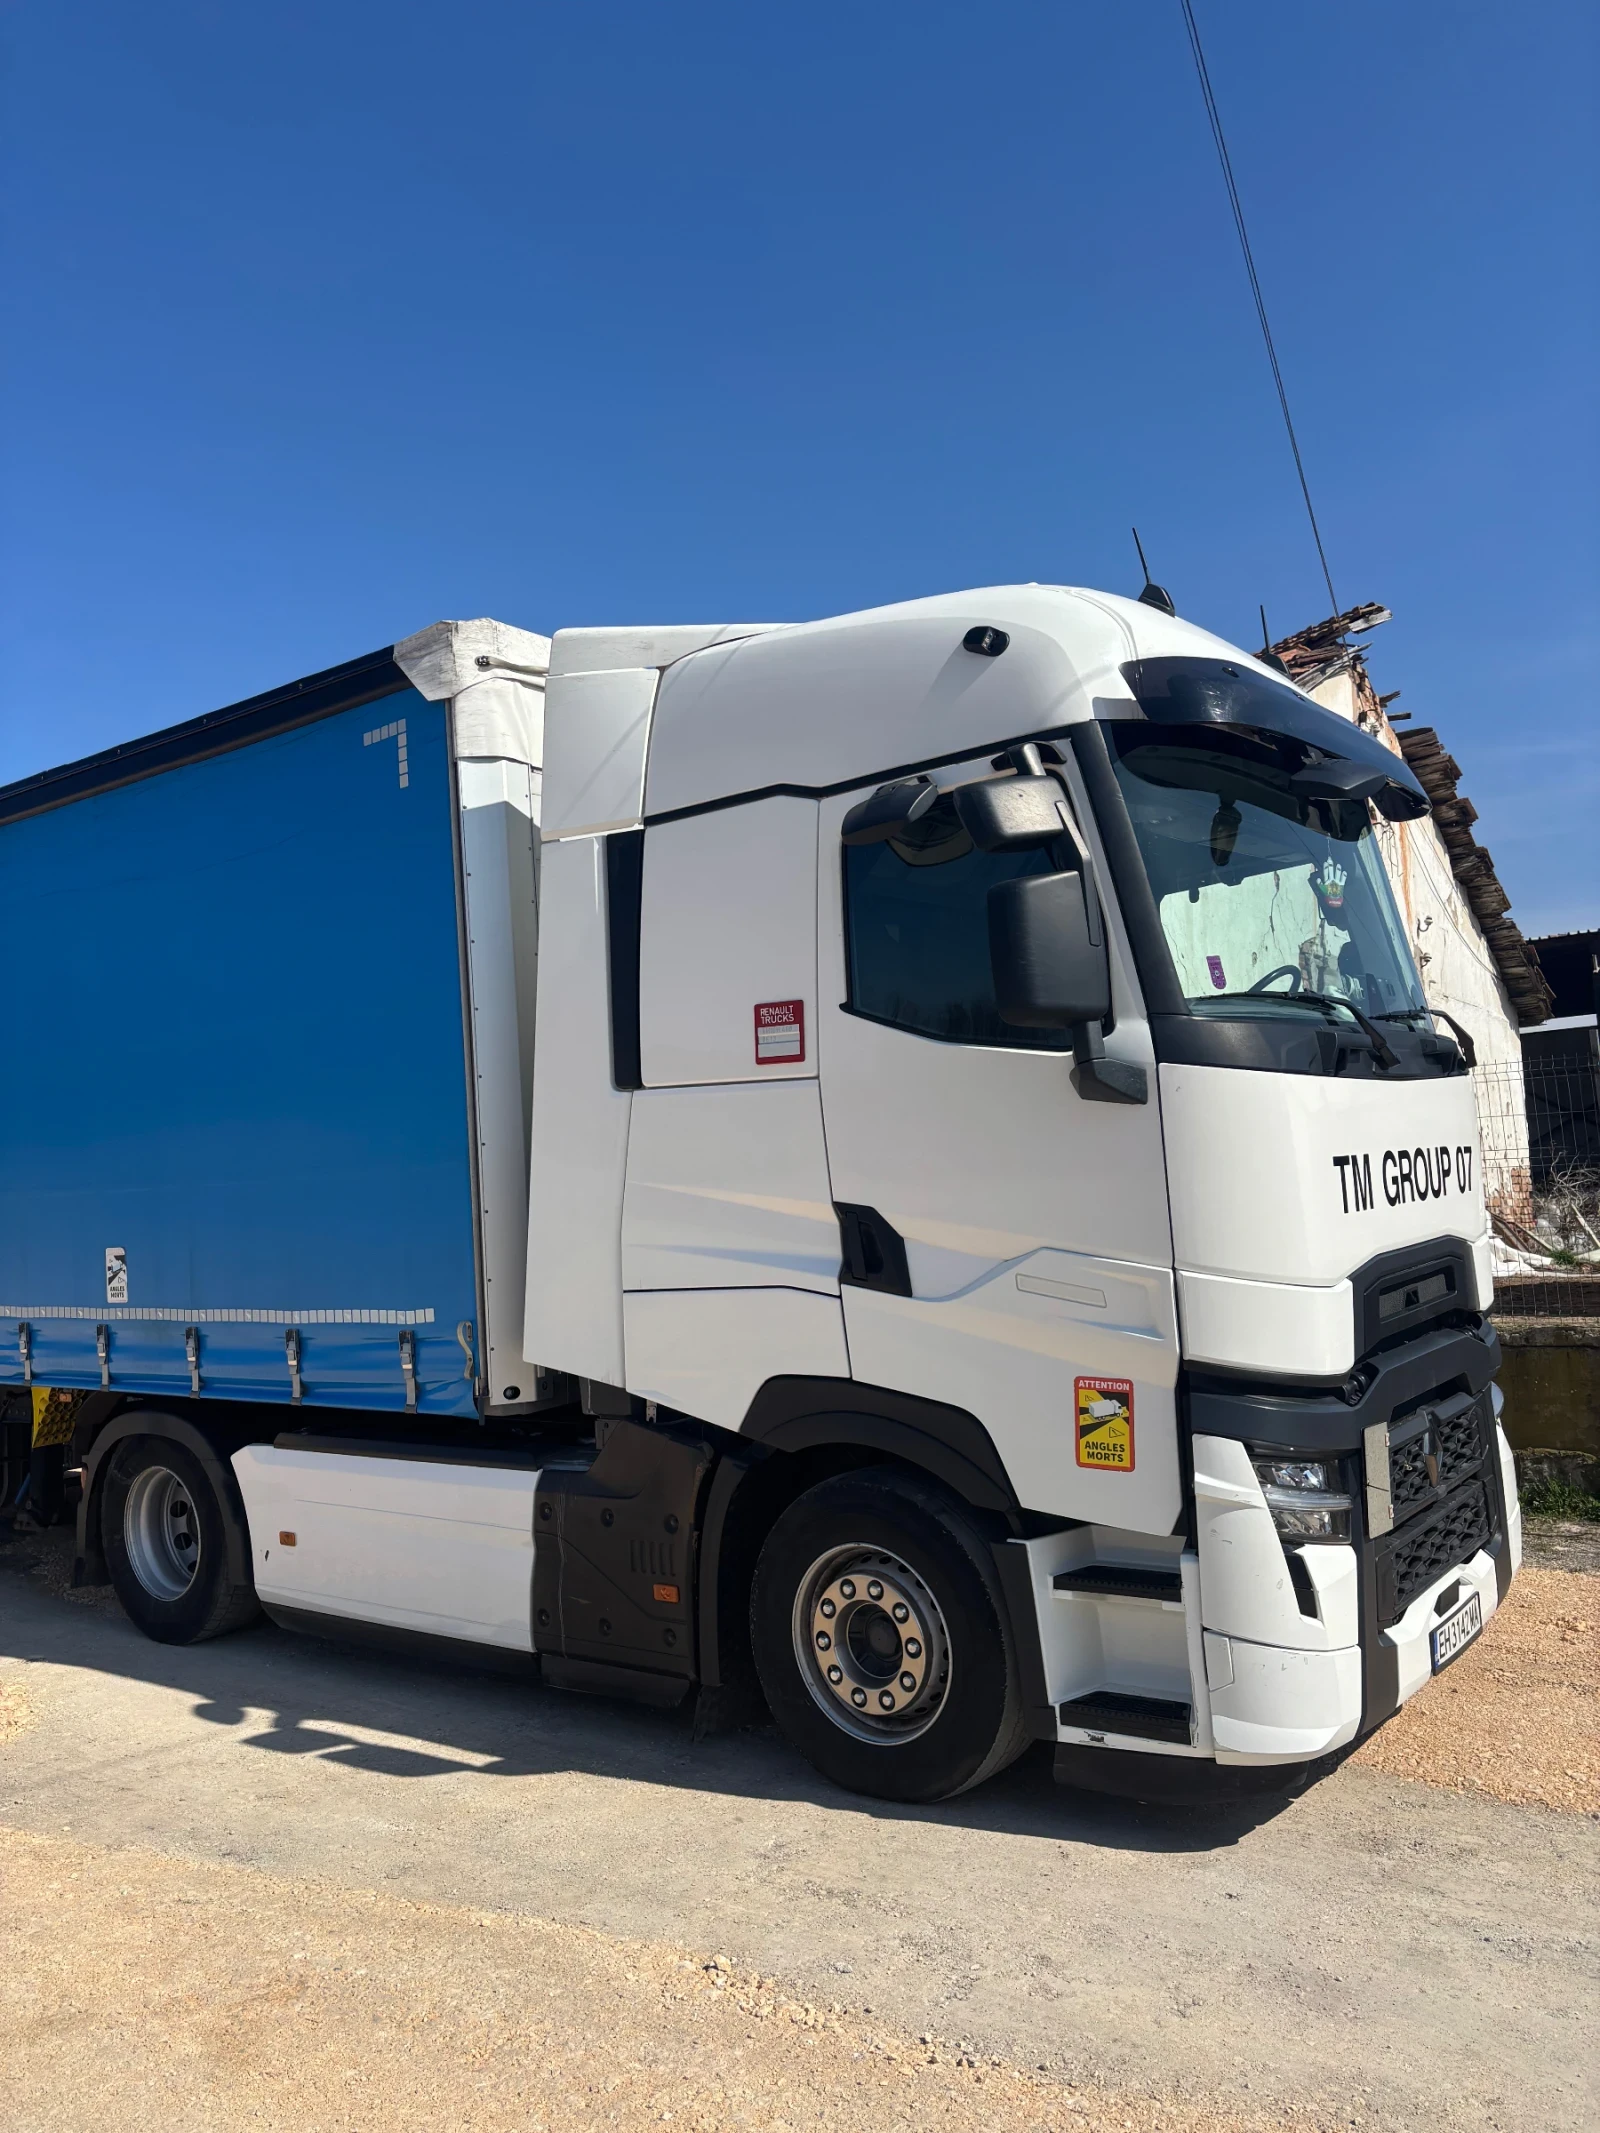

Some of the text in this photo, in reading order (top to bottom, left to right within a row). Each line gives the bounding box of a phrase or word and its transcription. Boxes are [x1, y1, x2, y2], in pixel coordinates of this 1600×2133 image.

[760, 1005, 794, 1017] RENAULT
[761, 1013, 795, 1025] TRUCKS
[1332, 1146, 1472, 1214] TM GROUP 07
[1078, 1379, 1130, 1391] ATTENTION
[1084, 1440, 1126, 1453] ANGLES
[1086, 1450, 1125, 1463] MORTS
